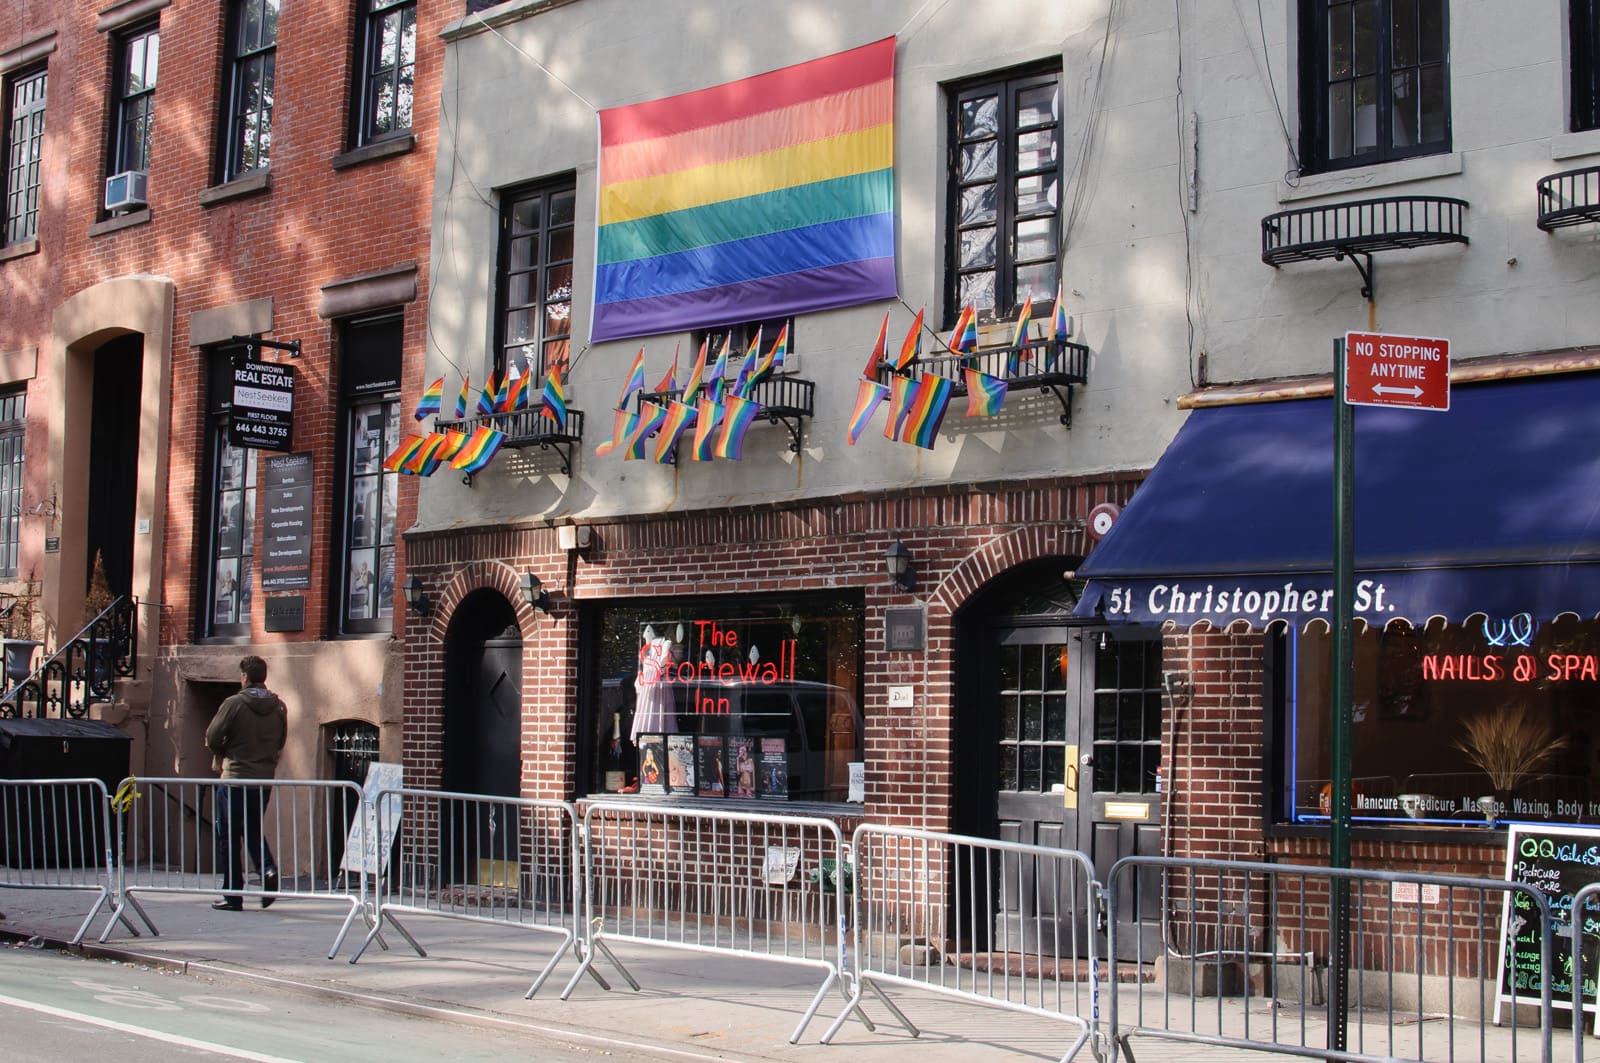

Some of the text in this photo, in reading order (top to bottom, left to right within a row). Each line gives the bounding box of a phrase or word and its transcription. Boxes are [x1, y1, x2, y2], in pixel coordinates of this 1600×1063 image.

[1355, 342, 1441, 361] NO STOPPING
[235, 370, 293, 388] REAL ESTATE
[246, 363, 284, 374] DOWNTOWN
[1370, 362, 1426, 380] ANYTIME
[247, 411, 260, 419] FIRST
[235, 424, 288, 437] 646 443 3755
[1109, 579, 1396, 620] 51 Christopher St.
[694, 621, 738, 648] The
[639, 639, 796, 686] Stonewall
[1423, 654, 1598, 682] NAILS & SPA
[694, 688, 731, 716] Inn
[1357, 793, 1398, 810] Manicure
[1414, 795, 1456, 812] Pedicure
[1512, 798, 1552, 819] Waxing,
[1557, 799, 1583, 820] Body
[1092, 958, 1100, 1019] NYPD
